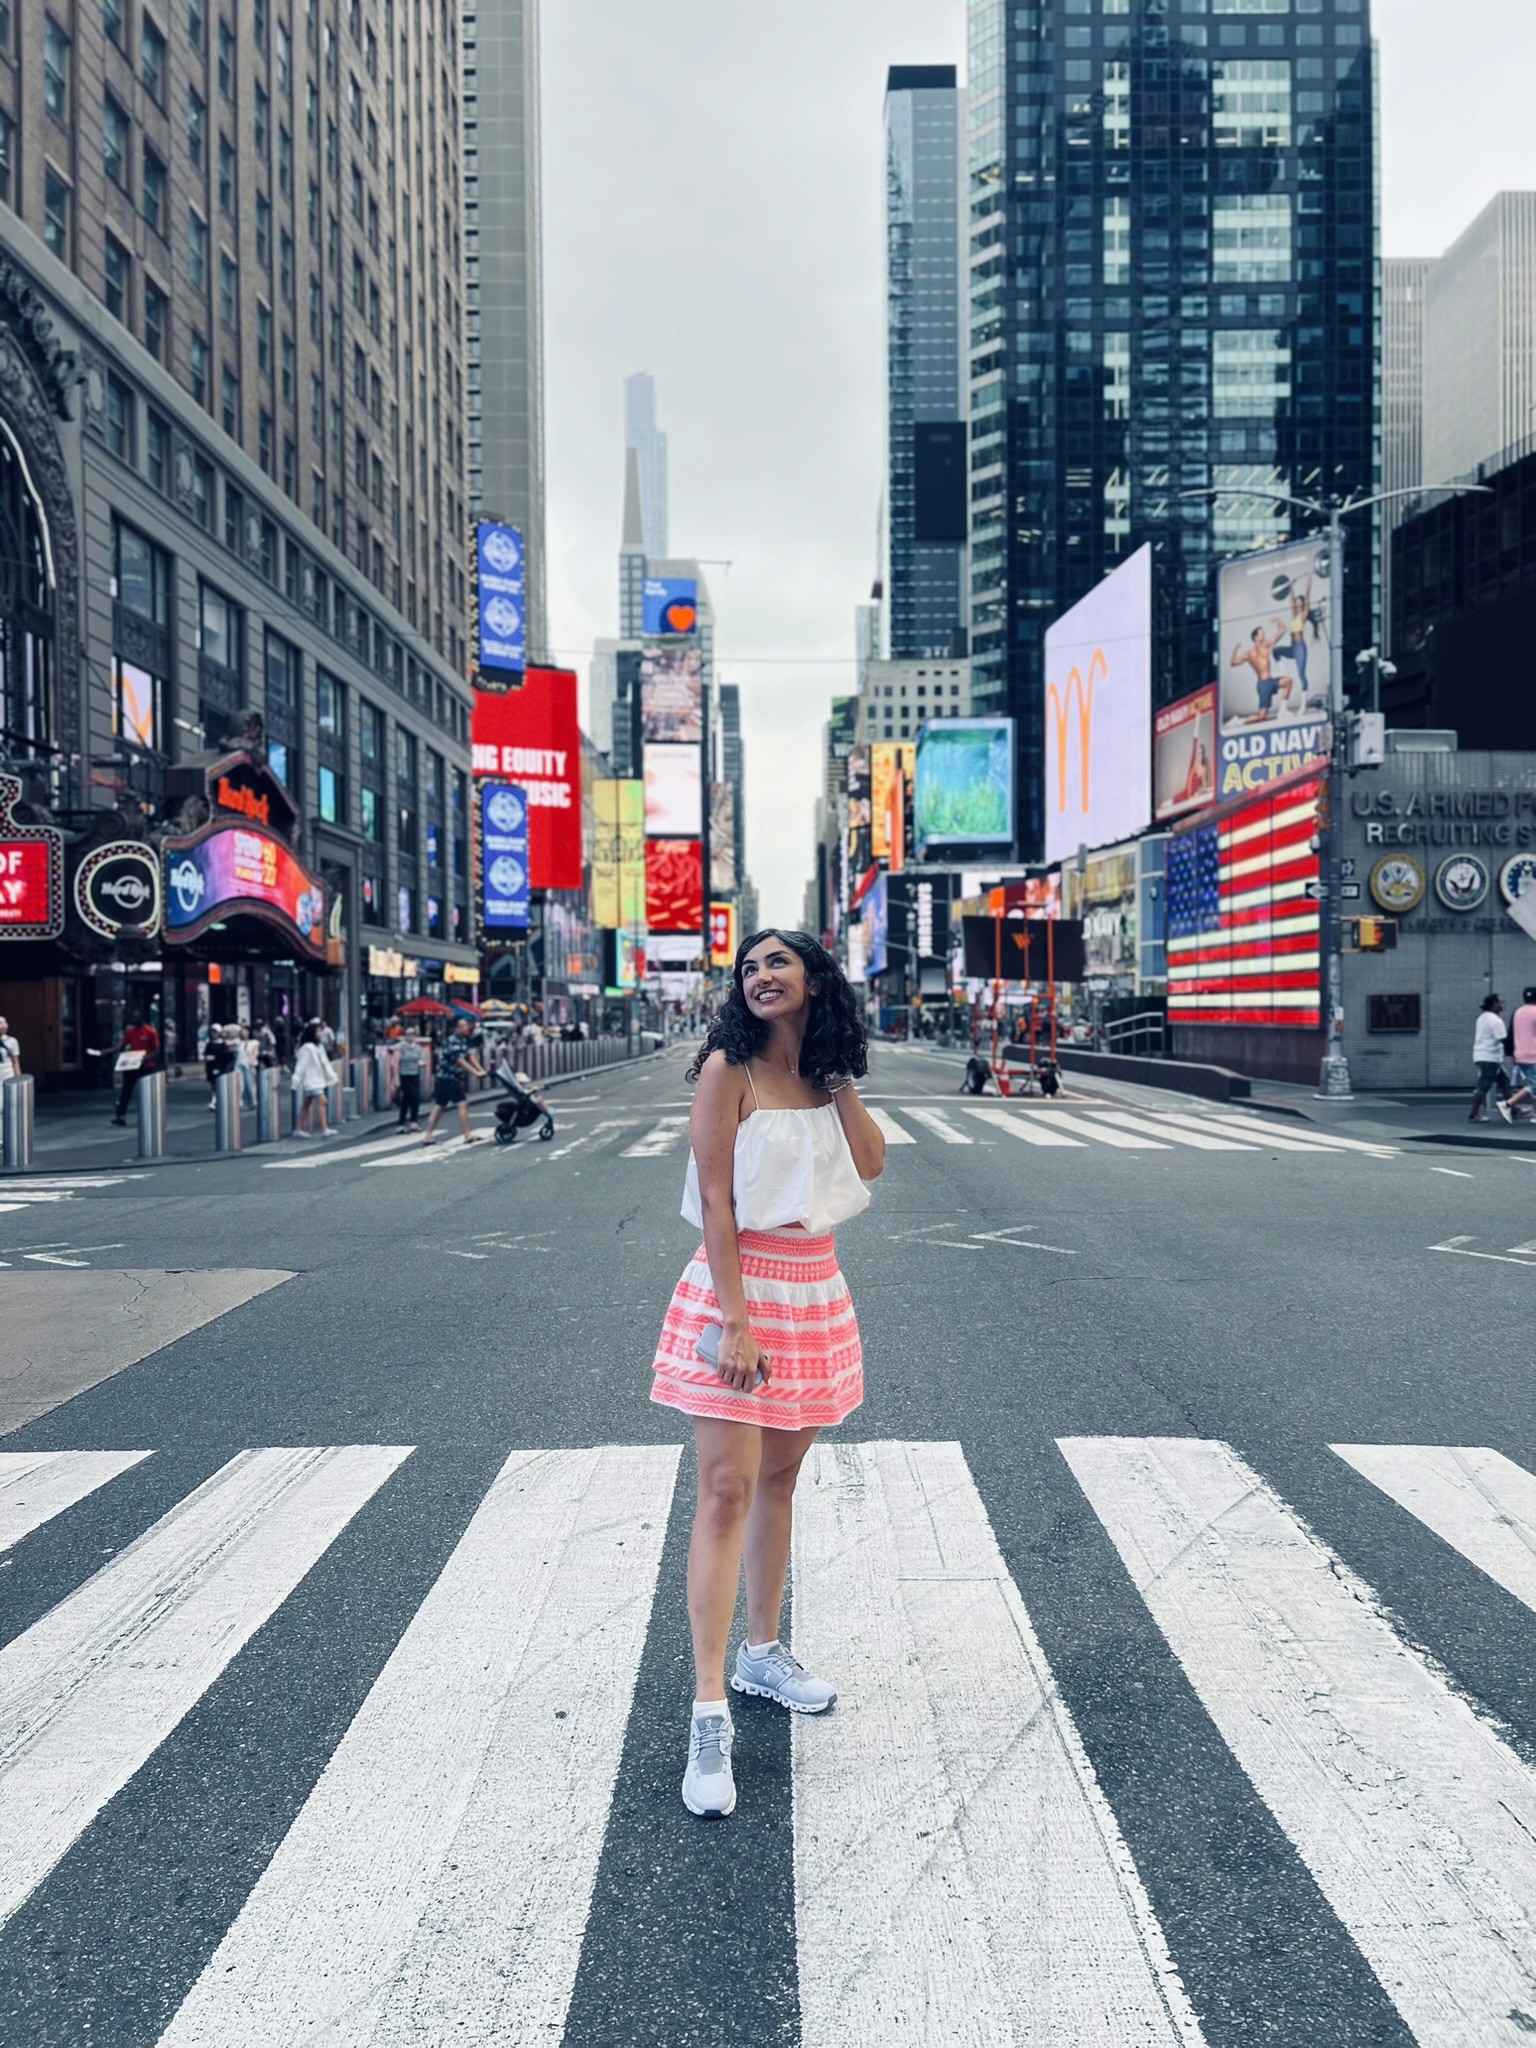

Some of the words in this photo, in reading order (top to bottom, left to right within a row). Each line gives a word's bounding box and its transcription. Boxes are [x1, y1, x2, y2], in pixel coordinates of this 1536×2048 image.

[501, 746, 568, 777] EQUITY
[1222, 734, 1266, 762] OLD
[1221, 751, 1318, 795] ACTIV
[1352, 789, 1401, 818] U.S.
[1406, 792, 1511, 820] ARMED
[1515, 792, 1536, 820] F
[1366, 822, 1510, 846] RECRUITING
[1516, 823, 1536, 847] S
